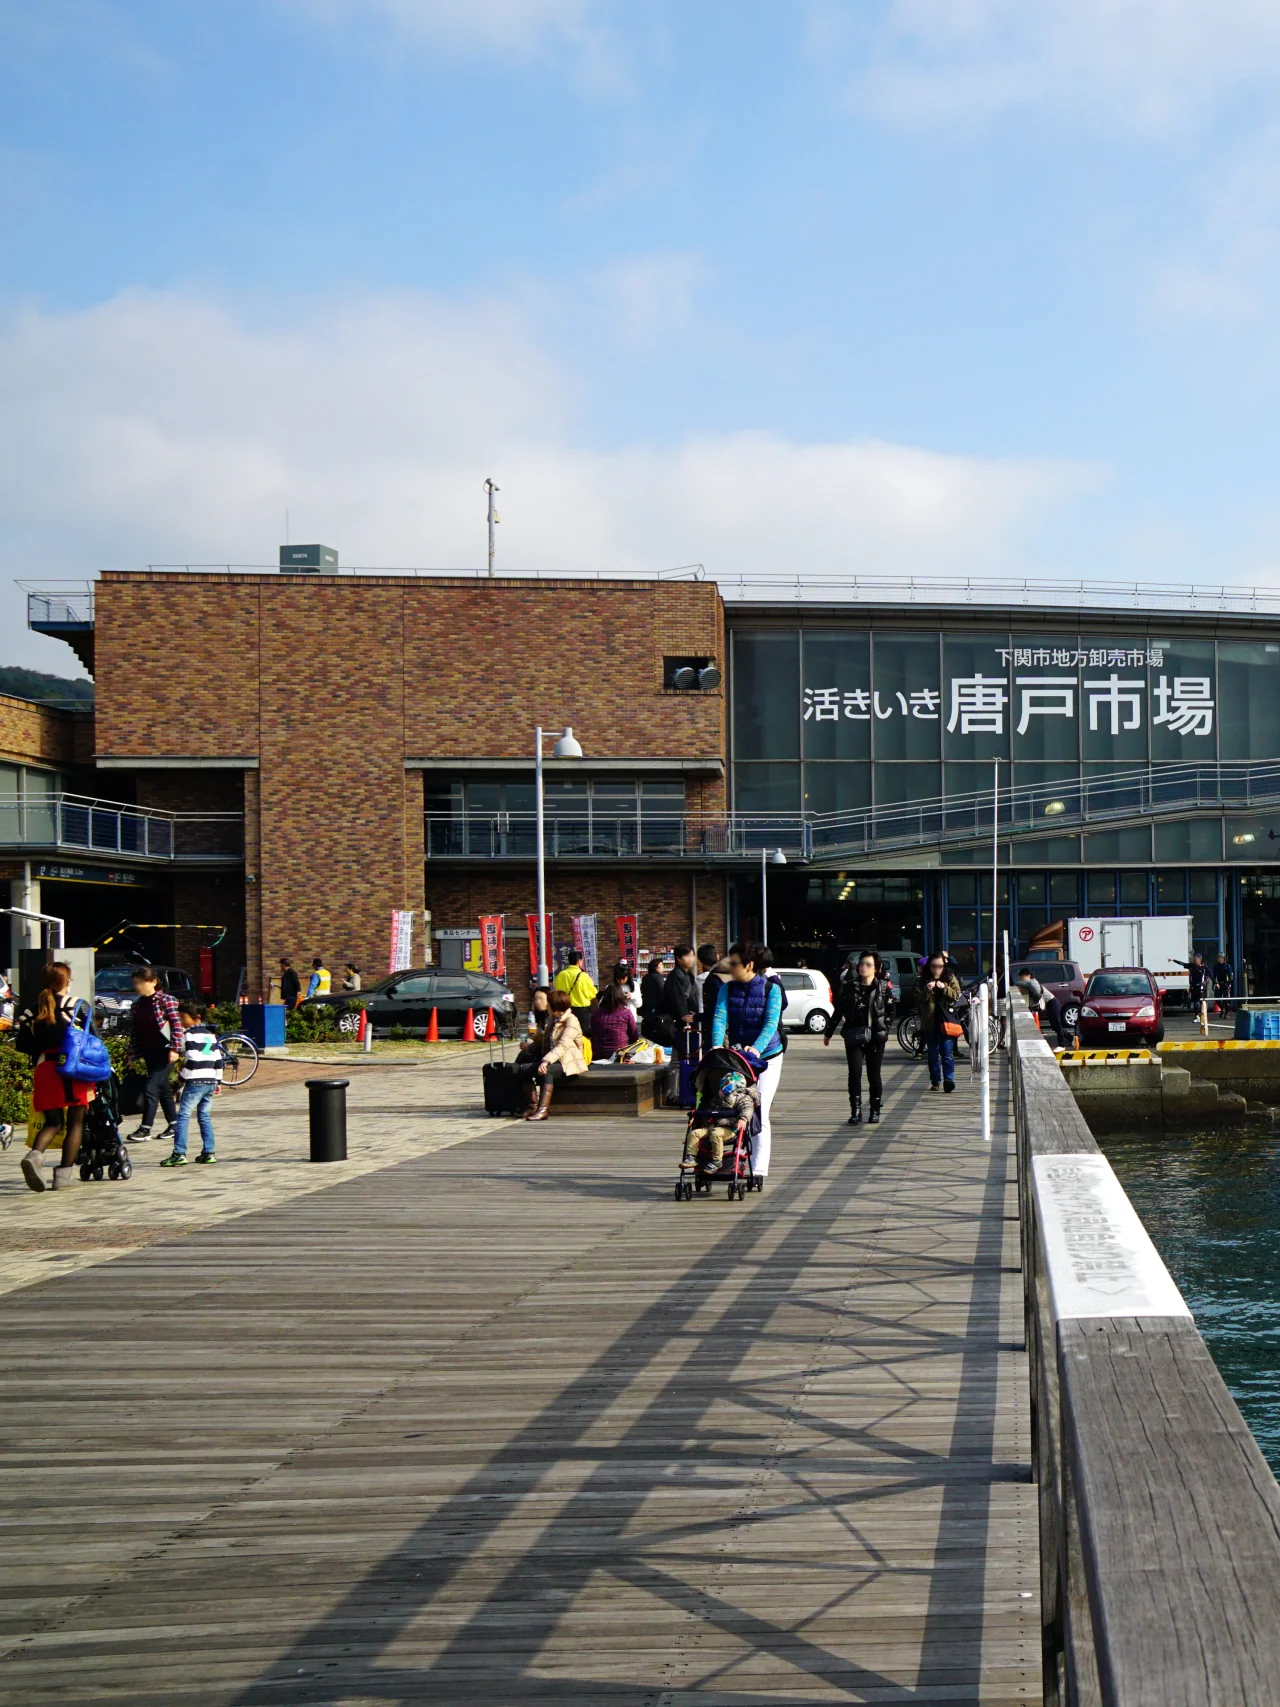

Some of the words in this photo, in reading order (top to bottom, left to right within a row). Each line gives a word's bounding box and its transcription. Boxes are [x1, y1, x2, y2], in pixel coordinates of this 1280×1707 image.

[995, 648, 1164, 667] 下関市地方卸売市場
[803, 687, 941, 721] 活きいき
[946, 673, 1214, 736] 唐戸市場
[202, 1036, 212, 1055] 2
